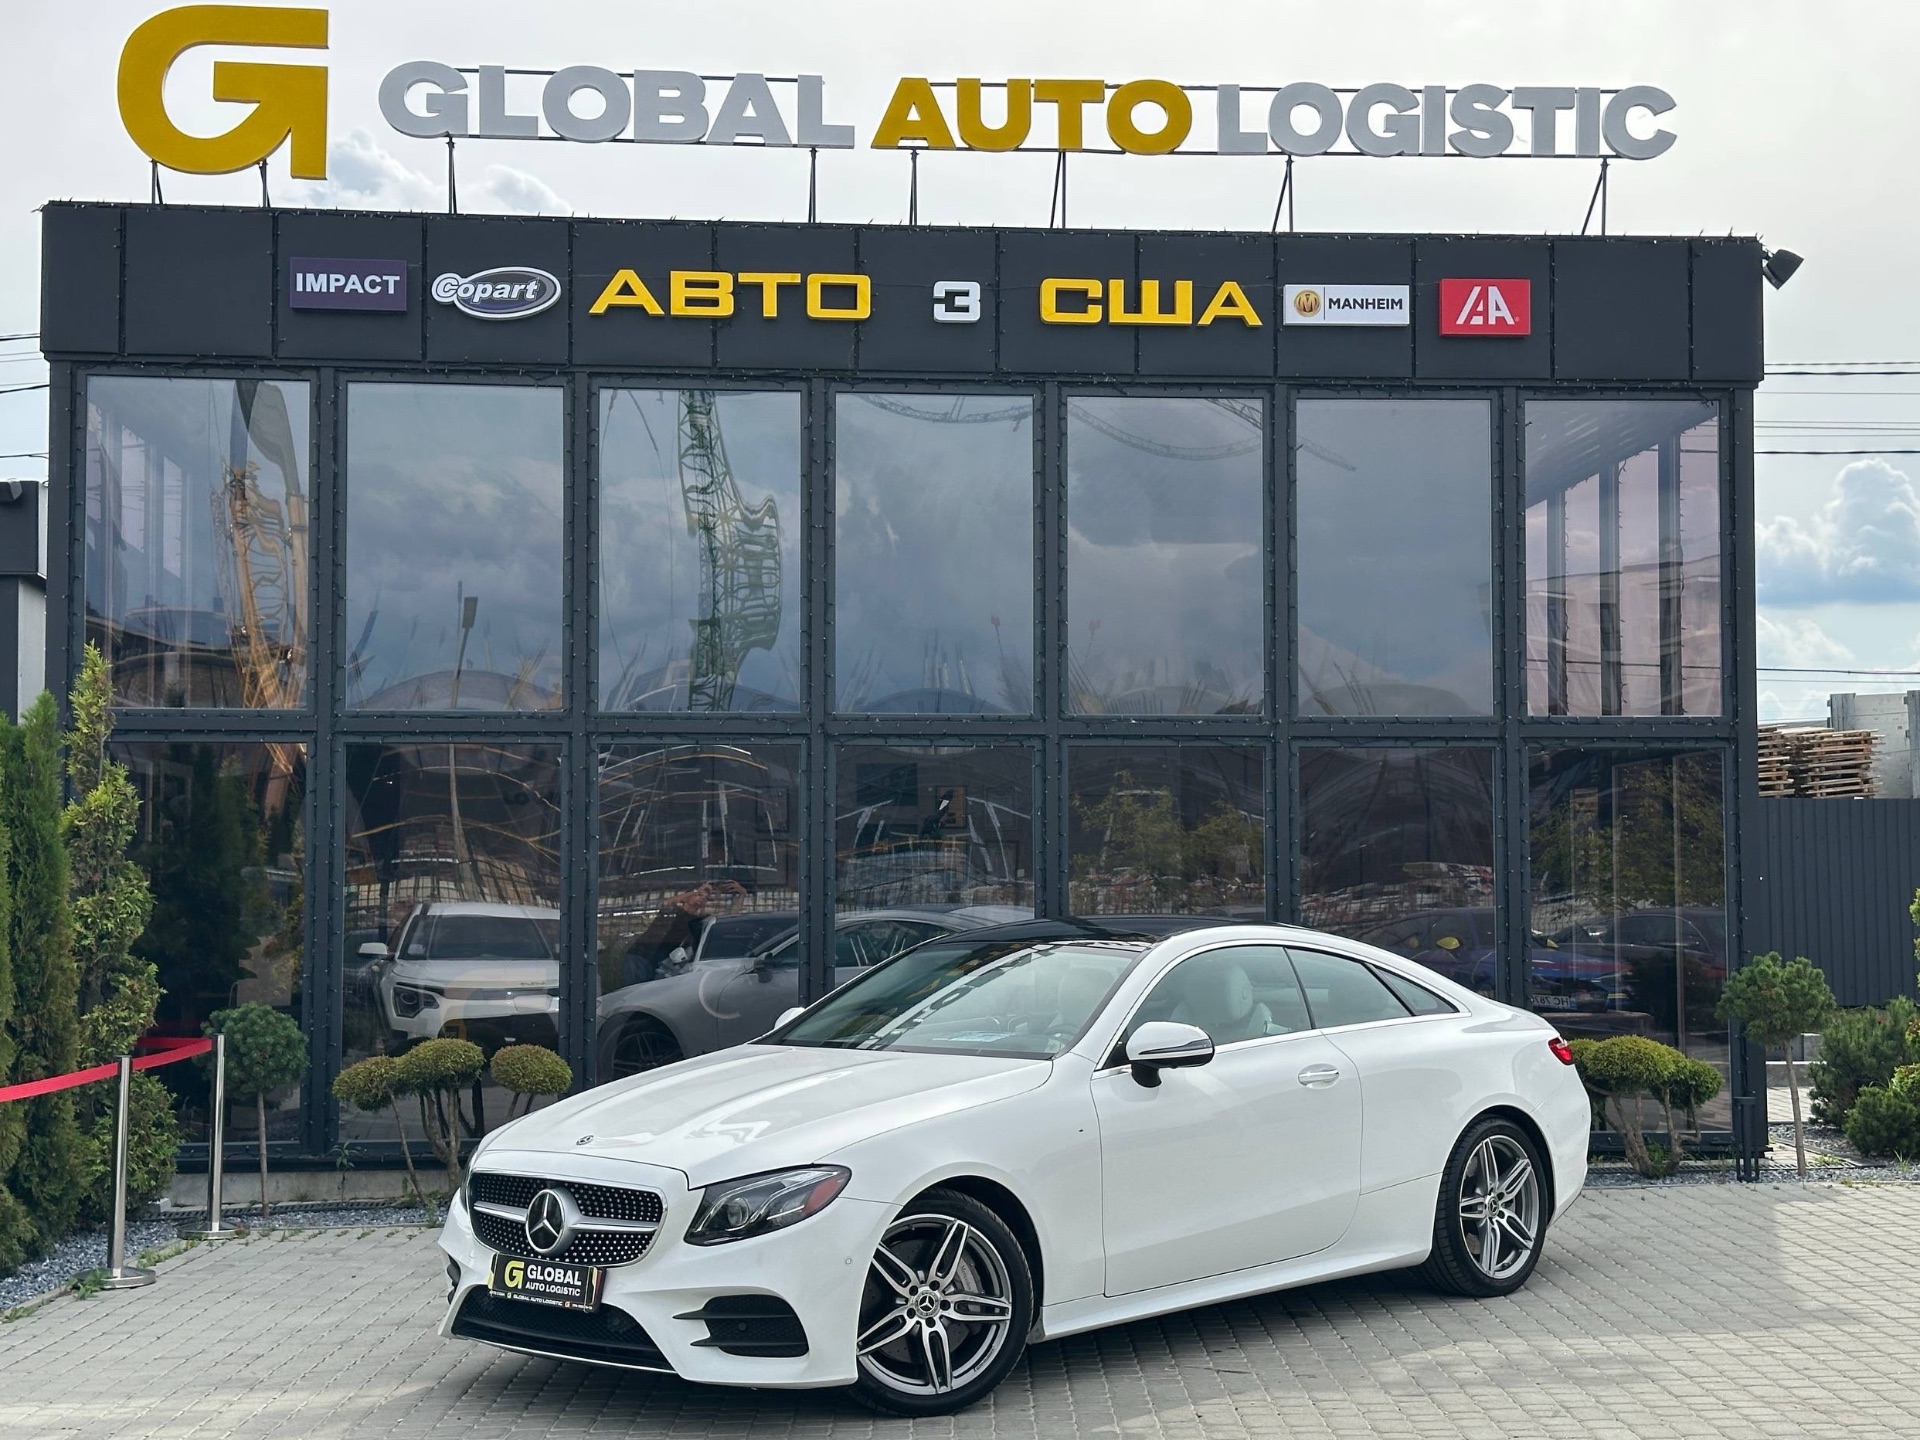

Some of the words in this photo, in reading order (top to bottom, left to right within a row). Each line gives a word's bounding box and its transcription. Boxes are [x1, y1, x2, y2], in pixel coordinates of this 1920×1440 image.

[378, 60, 856, 149] GLOBAL
[872, 77, 1193, 155] AUTO
[1216, 81, 1678, 160] LOGISTIC
[296, 272, 400, 294] IMPACT
[437, 277, 540, 304] Copart
[590, 270, 870, 319] АВТО
[1040, 278, 1261, 327] США
[1328, 298, 1403, 310] MANHEIM
[527, 1264, 582, 1286] GLOBAL
[525, 1281, 545, 1292] AUTO
[546, 1284, 580, 1297] LOGISTIC
